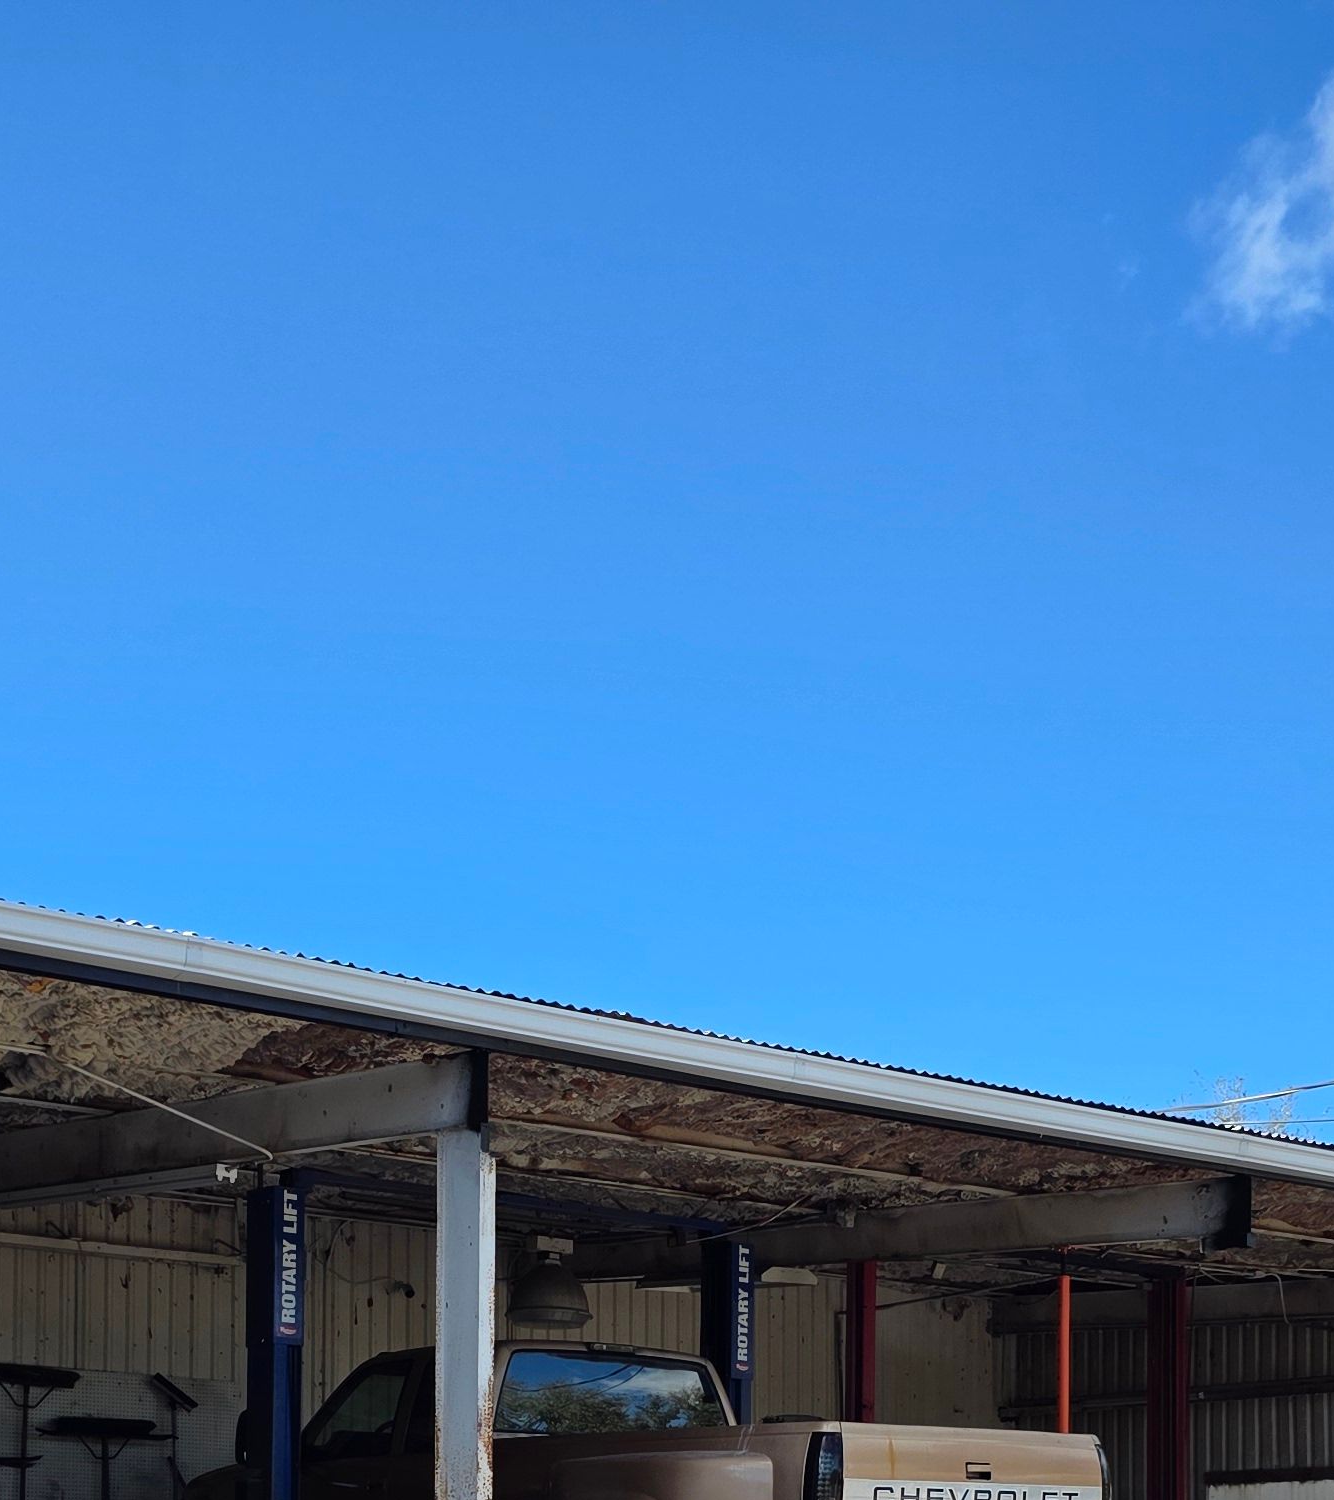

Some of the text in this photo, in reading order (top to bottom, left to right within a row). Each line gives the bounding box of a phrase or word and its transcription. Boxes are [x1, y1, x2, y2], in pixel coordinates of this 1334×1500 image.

[283, 1189, 298, 1234] LIFT
[281, 1239, 297, 1324] ROTARY
[738, 1244, 750, 1283] LIFT
[737, 1288, 749, 1362] ROTARY
